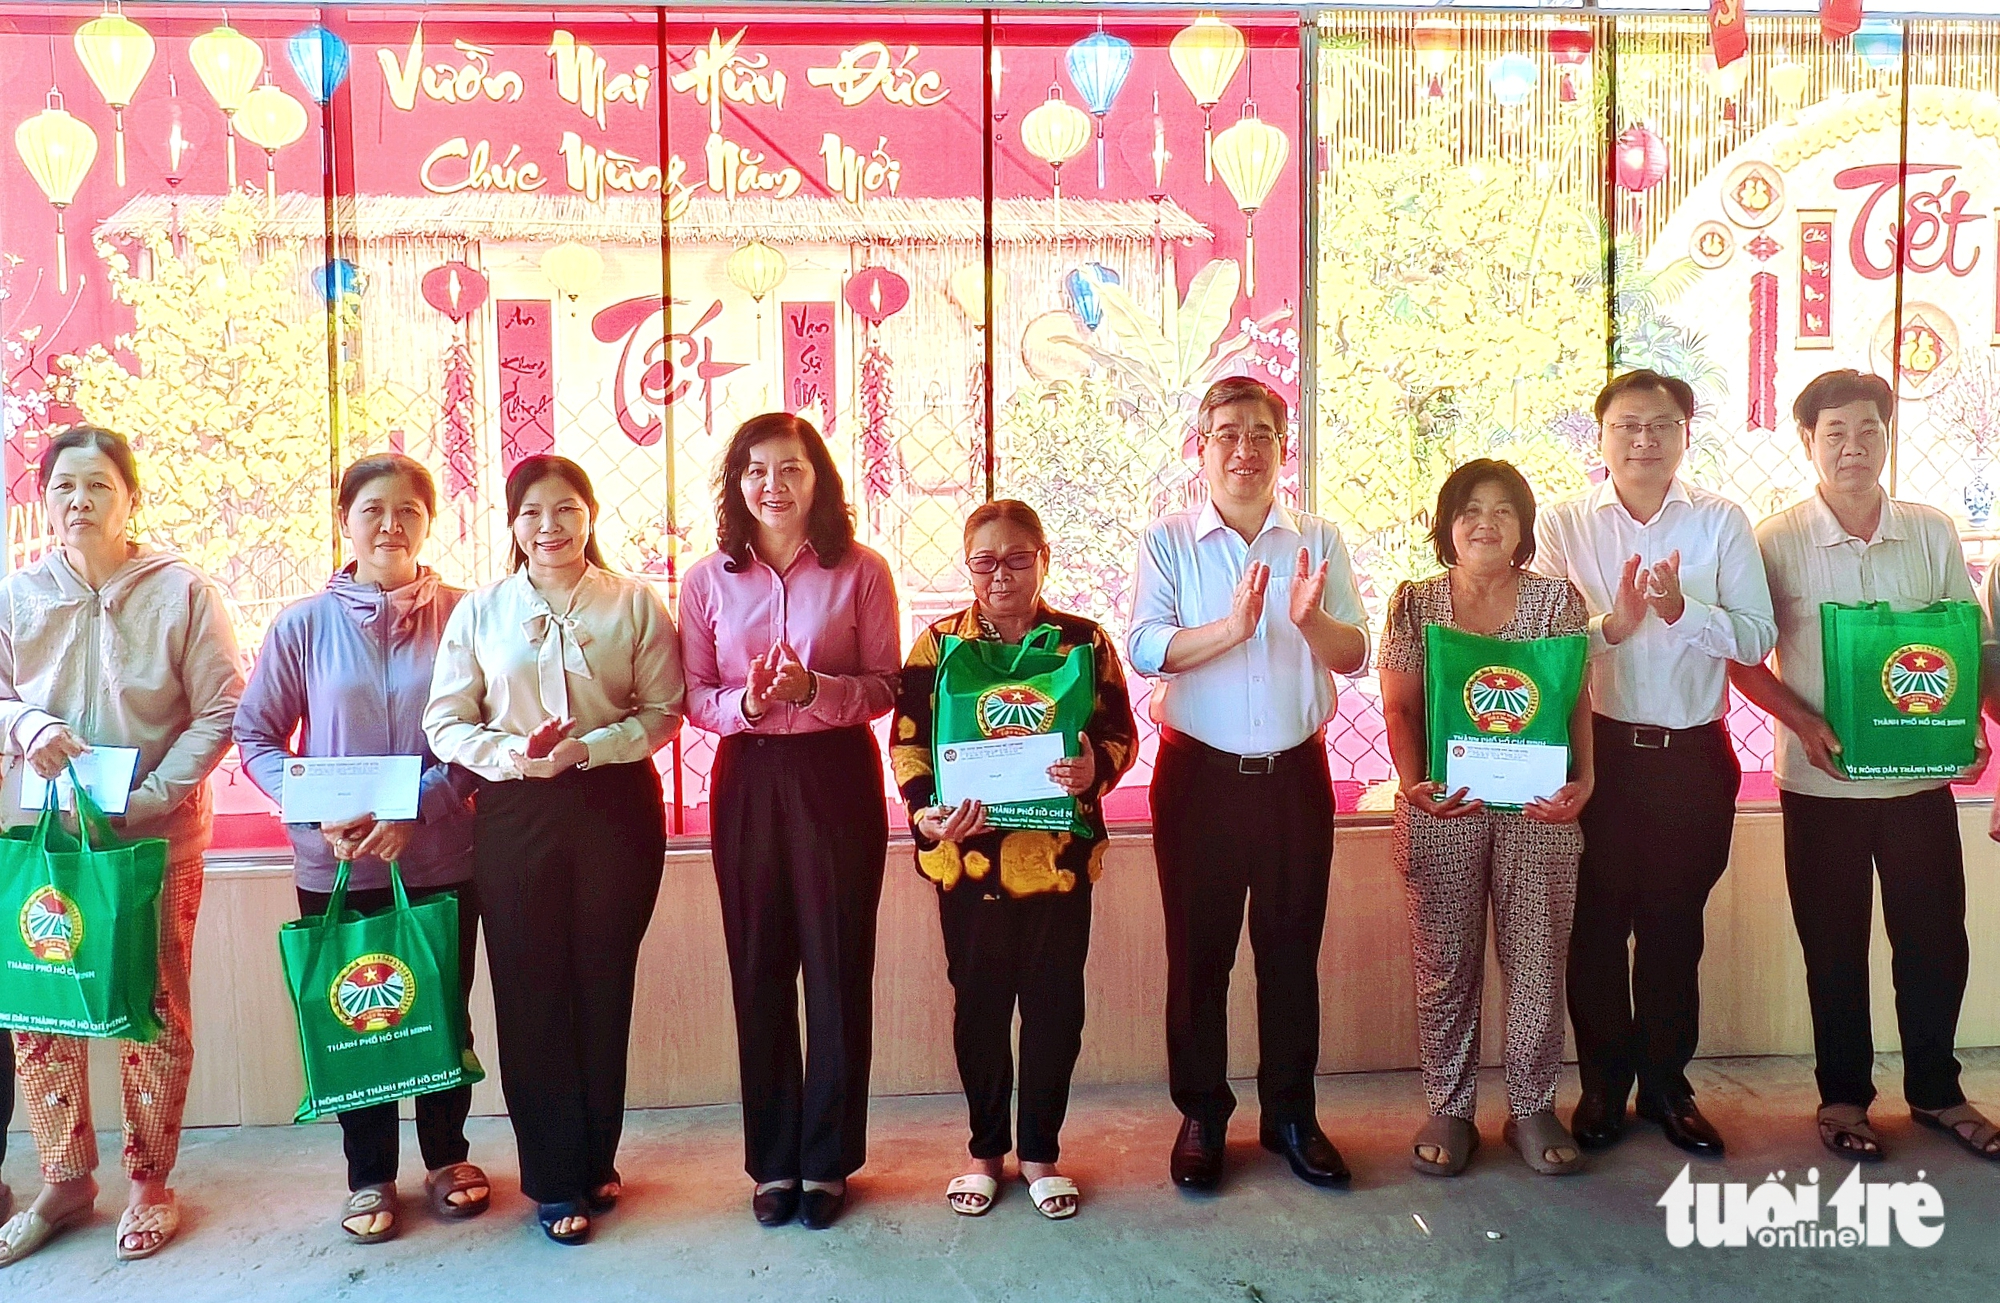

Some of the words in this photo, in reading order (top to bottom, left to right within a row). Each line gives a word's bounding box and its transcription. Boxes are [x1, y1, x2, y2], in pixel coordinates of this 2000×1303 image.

[377, 18, 523, 111] Vườn
[546, 29, 651, 131] Mai
[671, 26, 787, 133] Hữu
[806, 41, 950, 106] Đức
[420, 137, 547, 193] Chúc
[558, 131, 706, 219] Mừng
[705, 132, 801, 201] Năm
[819, 132, 900, 214] Mới
[1834, 163, 1987, 280] Tết
[791, 304, 829, 338] Vạn
[592, 293, 750, 446] Tết
[1873, 718, 1899, 726] THÀNH
[1901, 717, 1916, 725] PHỐ
[1919, 717, 1930, 725] HỒ
[1882, 765, 1898, 773] DÂN
[1900, 765, 1925, 773] THÀNH
[1927, 764, 1943, 773] PHỐ
[1944, 765, 1956, 773] HỒ
[987, 805, 1015, 814] THÀNH
[1016, 806, 1034, 816] PHỐ
[1049, 808, 1064, 817] CHÍ
[7, 960, 34, 971] THÀNH
[35, 964, 53, 973] PHỐ
[59, 1019, 77, 1029] PHỐ
[327, 1038, 358, 1053] THÀNH
[359, 1035, 379, 1047] PHỐ
[379, 1031, 393, 1042] HỒ
[393, 1028, 410, 1040] CHÍ
[318, 1093, 347, 1107] NÔNG
[346, 1087, 366, 1102] DÂN
[366, 1081, 397, 1096] THÀNH
[397, 1076, 417, 1091] PHỐ
[417, 1073, 431, 1085] HỒ
[431, 1070, 447, 1082] CHÍ
